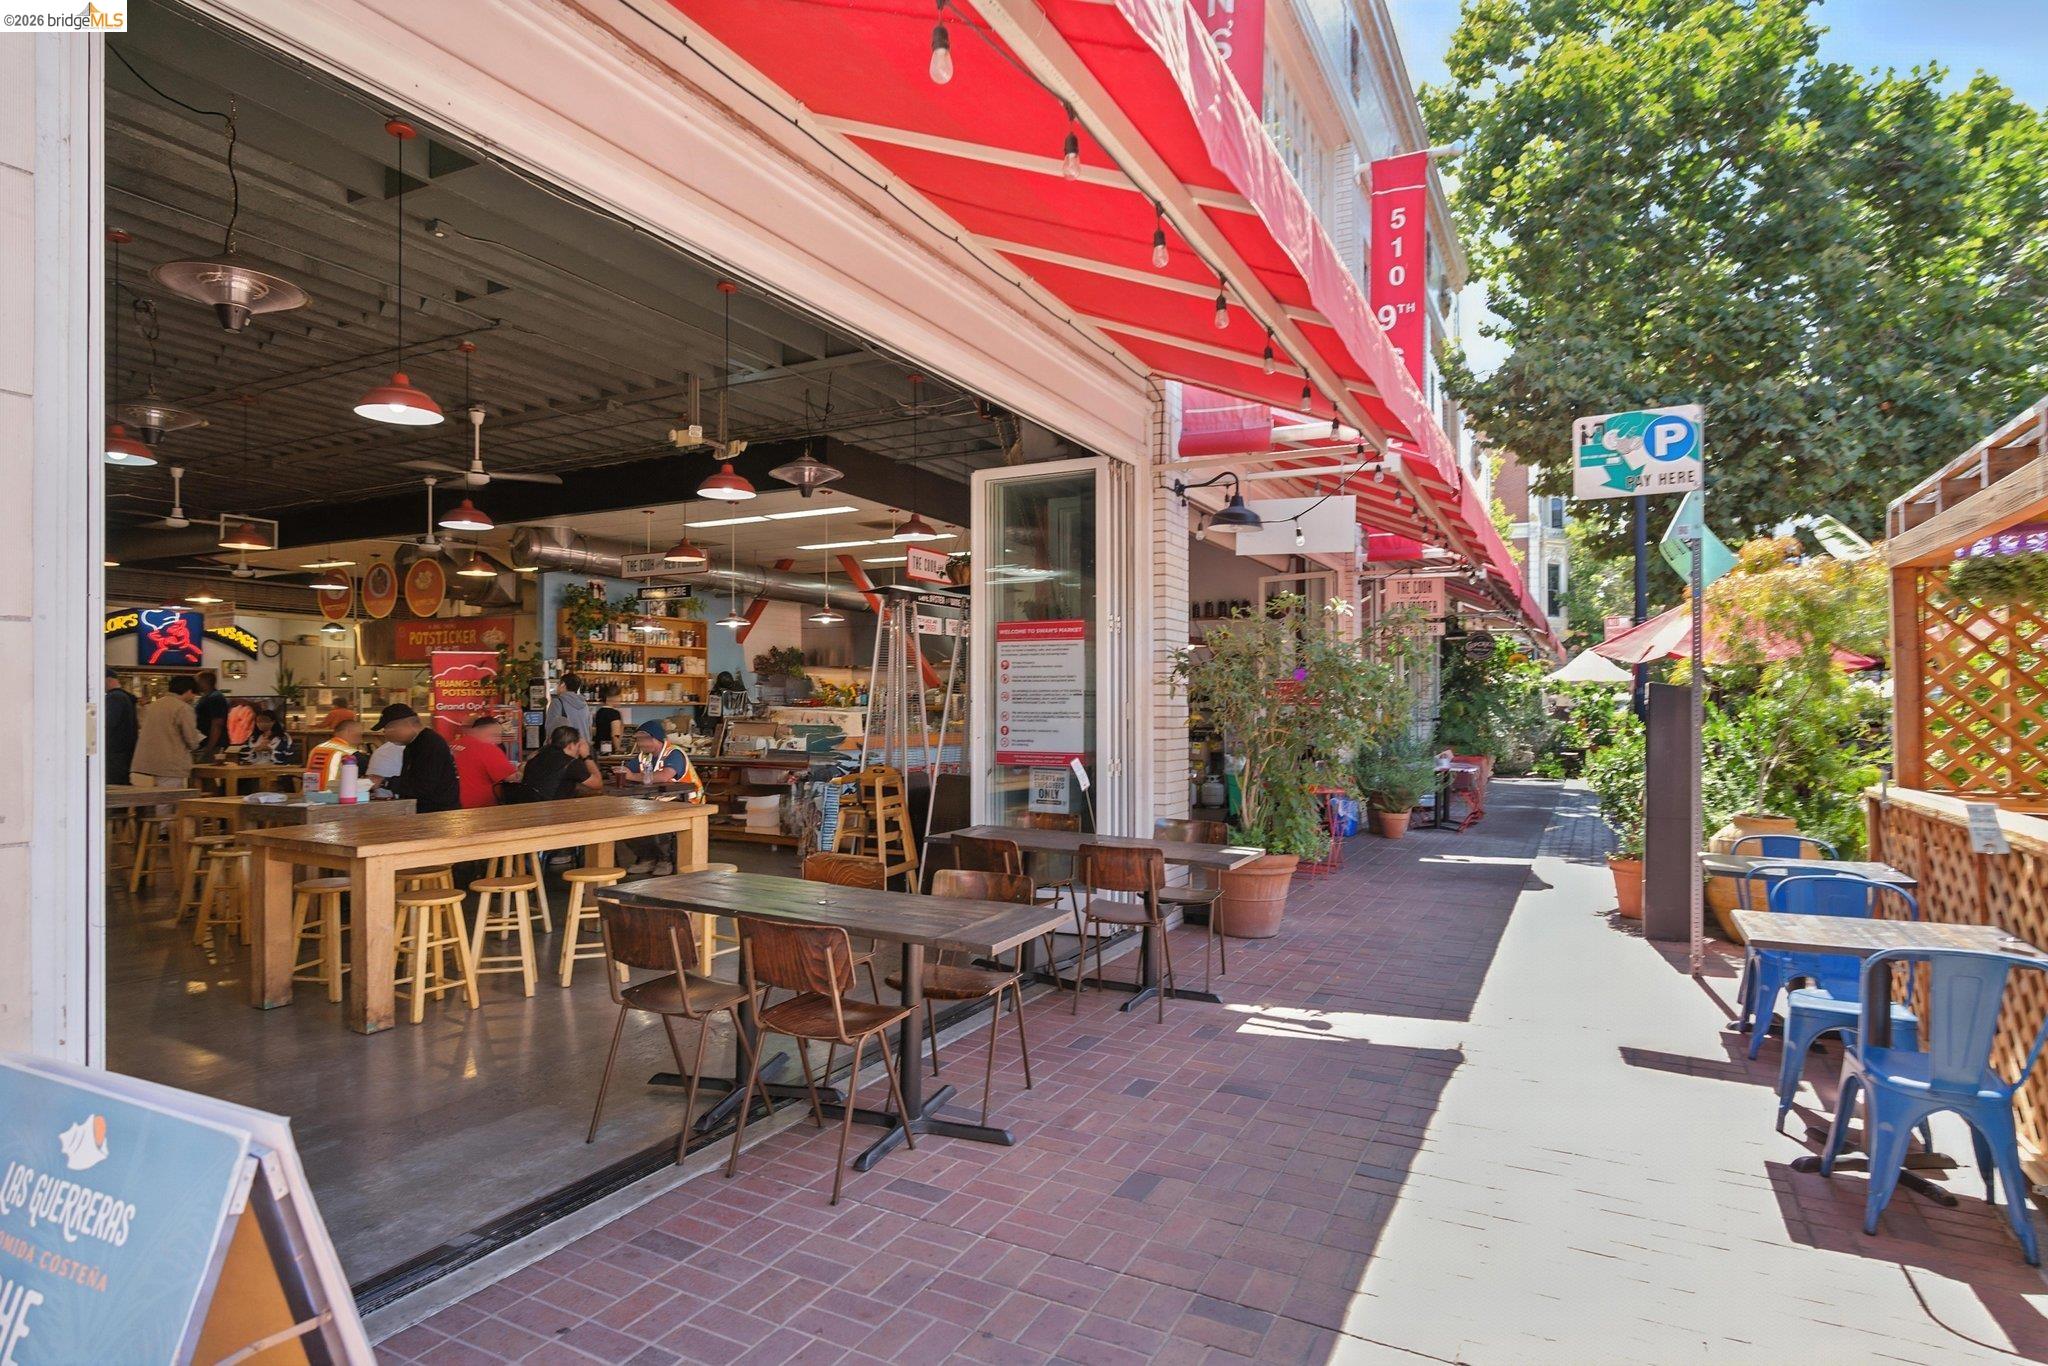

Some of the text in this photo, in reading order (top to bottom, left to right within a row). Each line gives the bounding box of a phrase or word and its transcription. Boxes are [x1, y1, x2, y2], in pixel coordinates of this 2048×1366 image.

[1654, 423, 1688, 457] P
[1625, 470, 1695, 489] PAY HERE
[1397, 580, 1432, 595] THE COOK
[408, 629, 477, 646] POTSTICKER
[436, 680, 469, 688] HUANG
[436, 702, 465, 711] Grand
[1038, 788, 1060, 799] ONLY
[0, 1161, 136, 1247] LAS GUERRERAS
[39, 1251, 109, 1293] COSTEÑA
